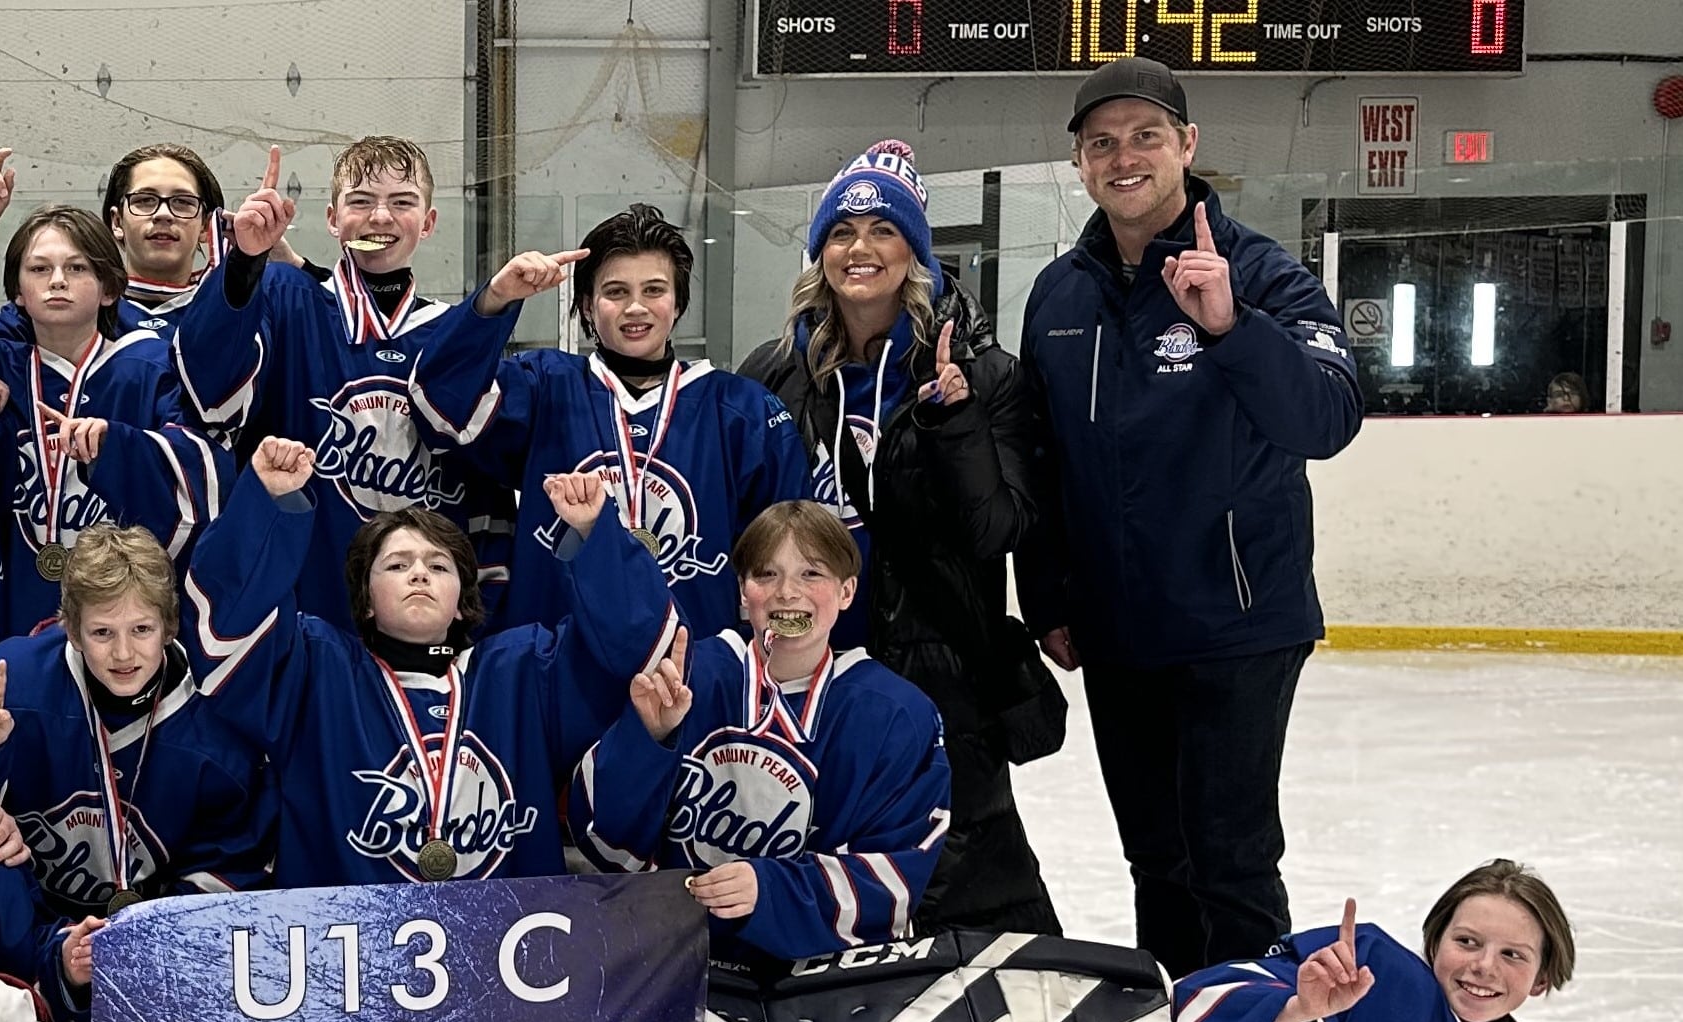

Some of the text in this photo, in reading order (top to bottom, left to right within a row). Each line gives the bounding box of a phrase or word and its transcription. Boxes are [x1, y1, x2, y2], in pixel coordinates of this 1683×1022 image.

[777, 17, 836, 33] SHOTS
[948, 23, 1030, 39] TIME OUT
[1263, 23, 1342, 39] TIME OUT
[1366, 17, 1422, 33] SHOTS
[1362, 105, 1414, 142] WEST
[1454, 132, 1489, 161] EXIT
[822, 153, 928, 202] ADES
[1368, 151, 1407, 187] EXIT
[368, 283, 402, 293] UER
[1047, 328, 1084, 337] BAUER
[1153, 334, 1204, 358] Blades
[1157, 363, 1193, 374] ALL STAR
[349, 396, 391, 415] MOUNT
[308, 397, 466, 510] Blades
[645, 476, 671, 502] ARL
[459, 751, 480, 776] EARL
[712, 748, 802, 794] MOUNT PEARL
[668, 755, 818, 861] Blade
[231, 911, 573, 1021] U13 C
[791, 937, 935, 977] CCM
